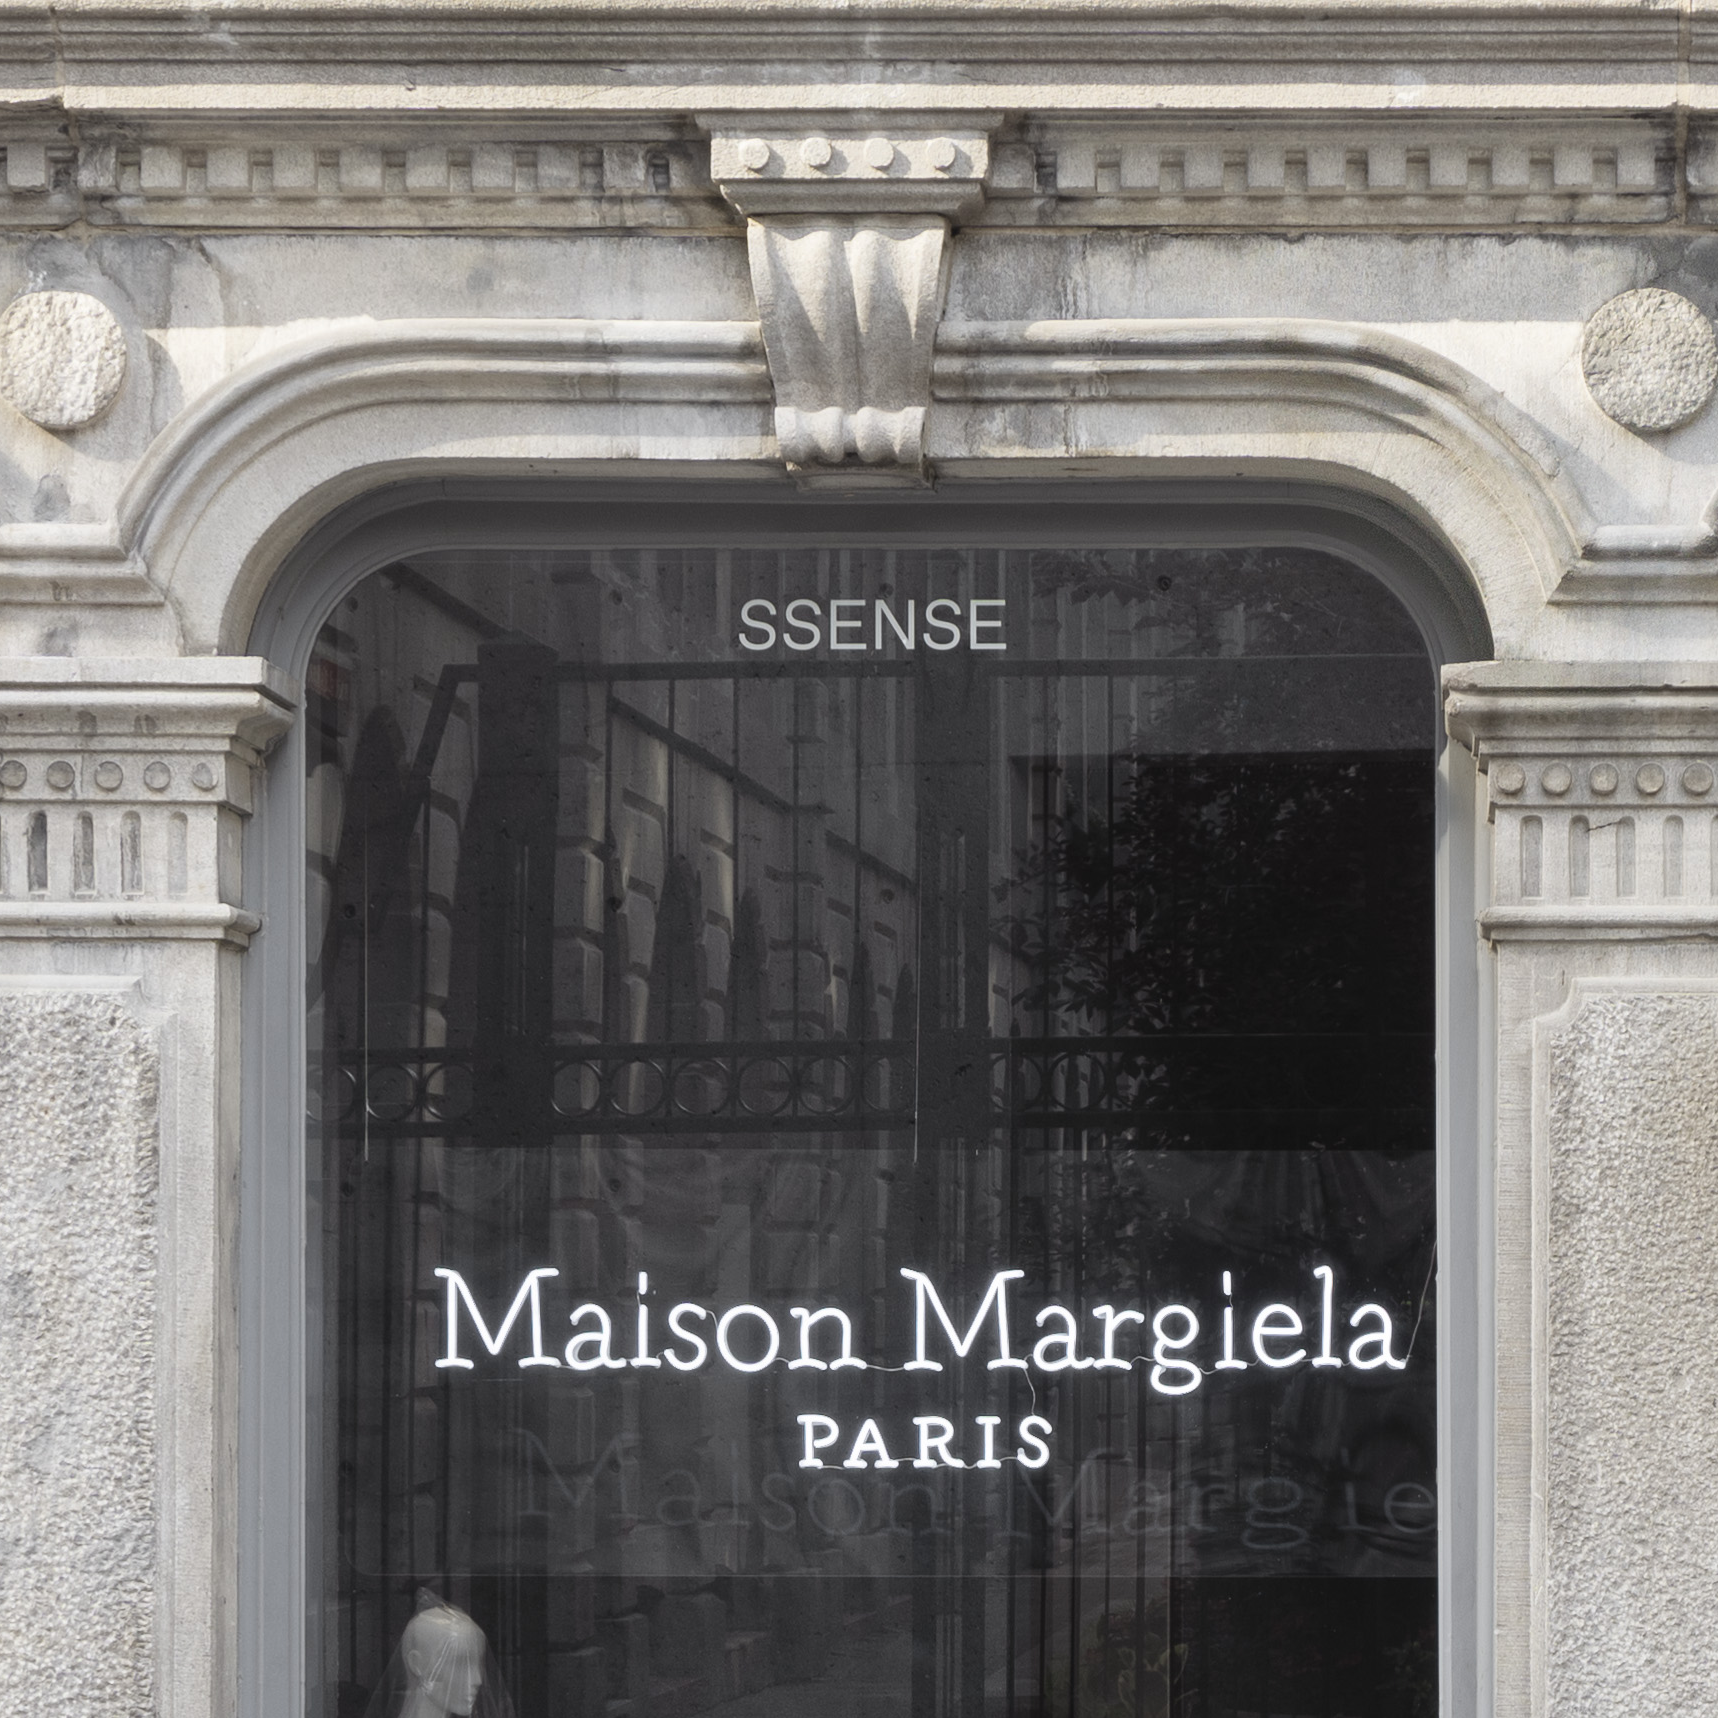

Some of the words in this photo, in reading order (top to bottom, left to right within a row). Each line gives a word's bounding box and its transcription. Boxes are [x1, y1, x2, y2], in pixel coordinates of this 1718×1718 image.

[738, 598, 1007, 651] SSENSE
[433, 1267, 869, 1372] Maison
[899, 1264, 1408, 1396] Margiela
[796, 1413, 1054, 1470] PARIS
